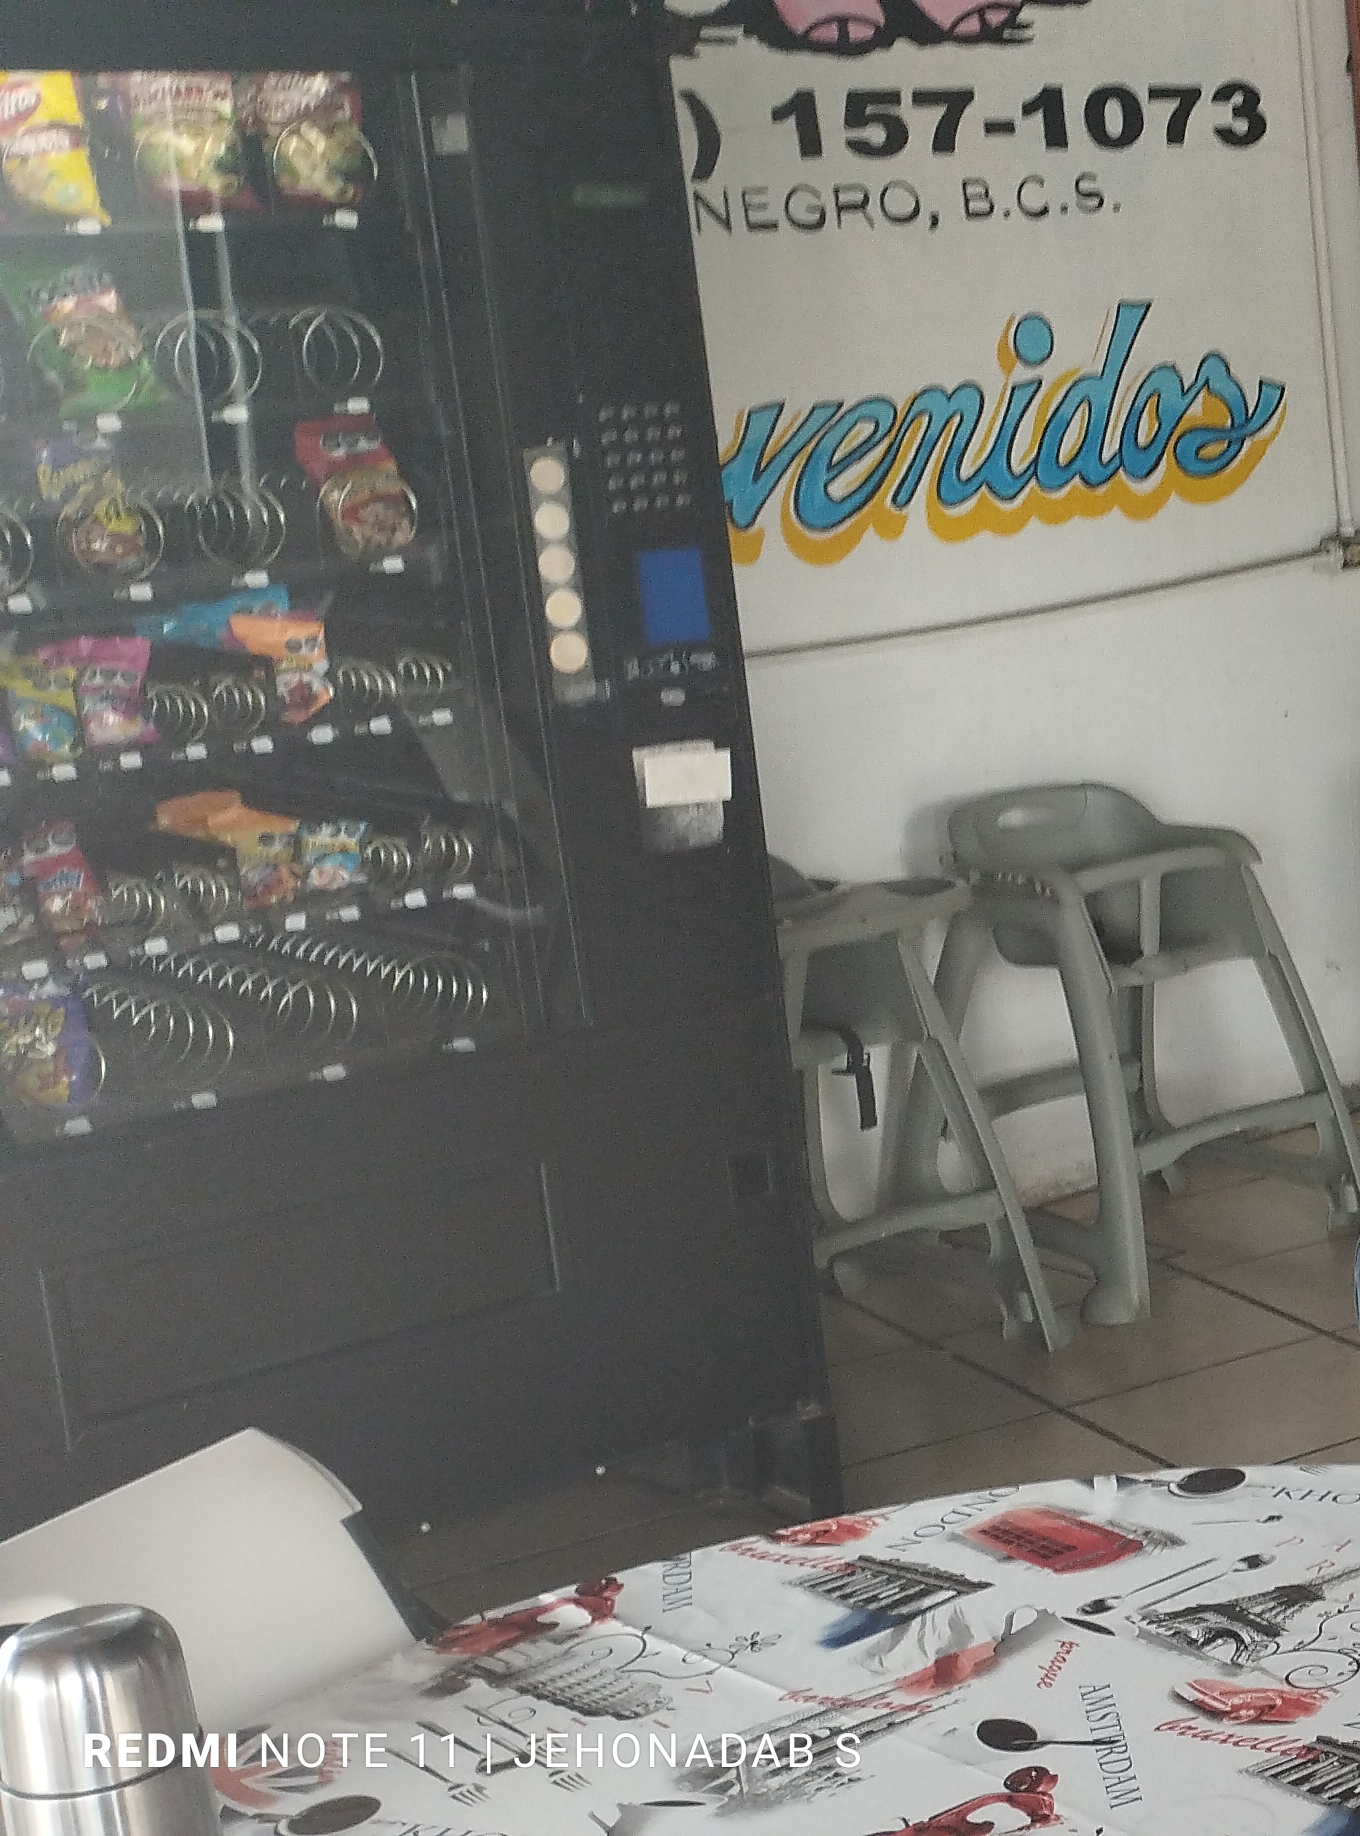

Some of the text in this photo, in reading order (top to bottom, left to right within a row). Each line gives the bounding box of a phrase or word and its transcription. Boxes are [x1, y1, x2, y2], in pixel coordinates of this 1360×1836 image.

[771, 80, 1267, 159] 157-1073
[692, 171, 1122, 236] NEGRO, B.C.S.
[720, 300, 1288, 565] venidos
[887, 1484, 1021, 1552] ONDON
[661, 1552, 693, 1614] RDAM
